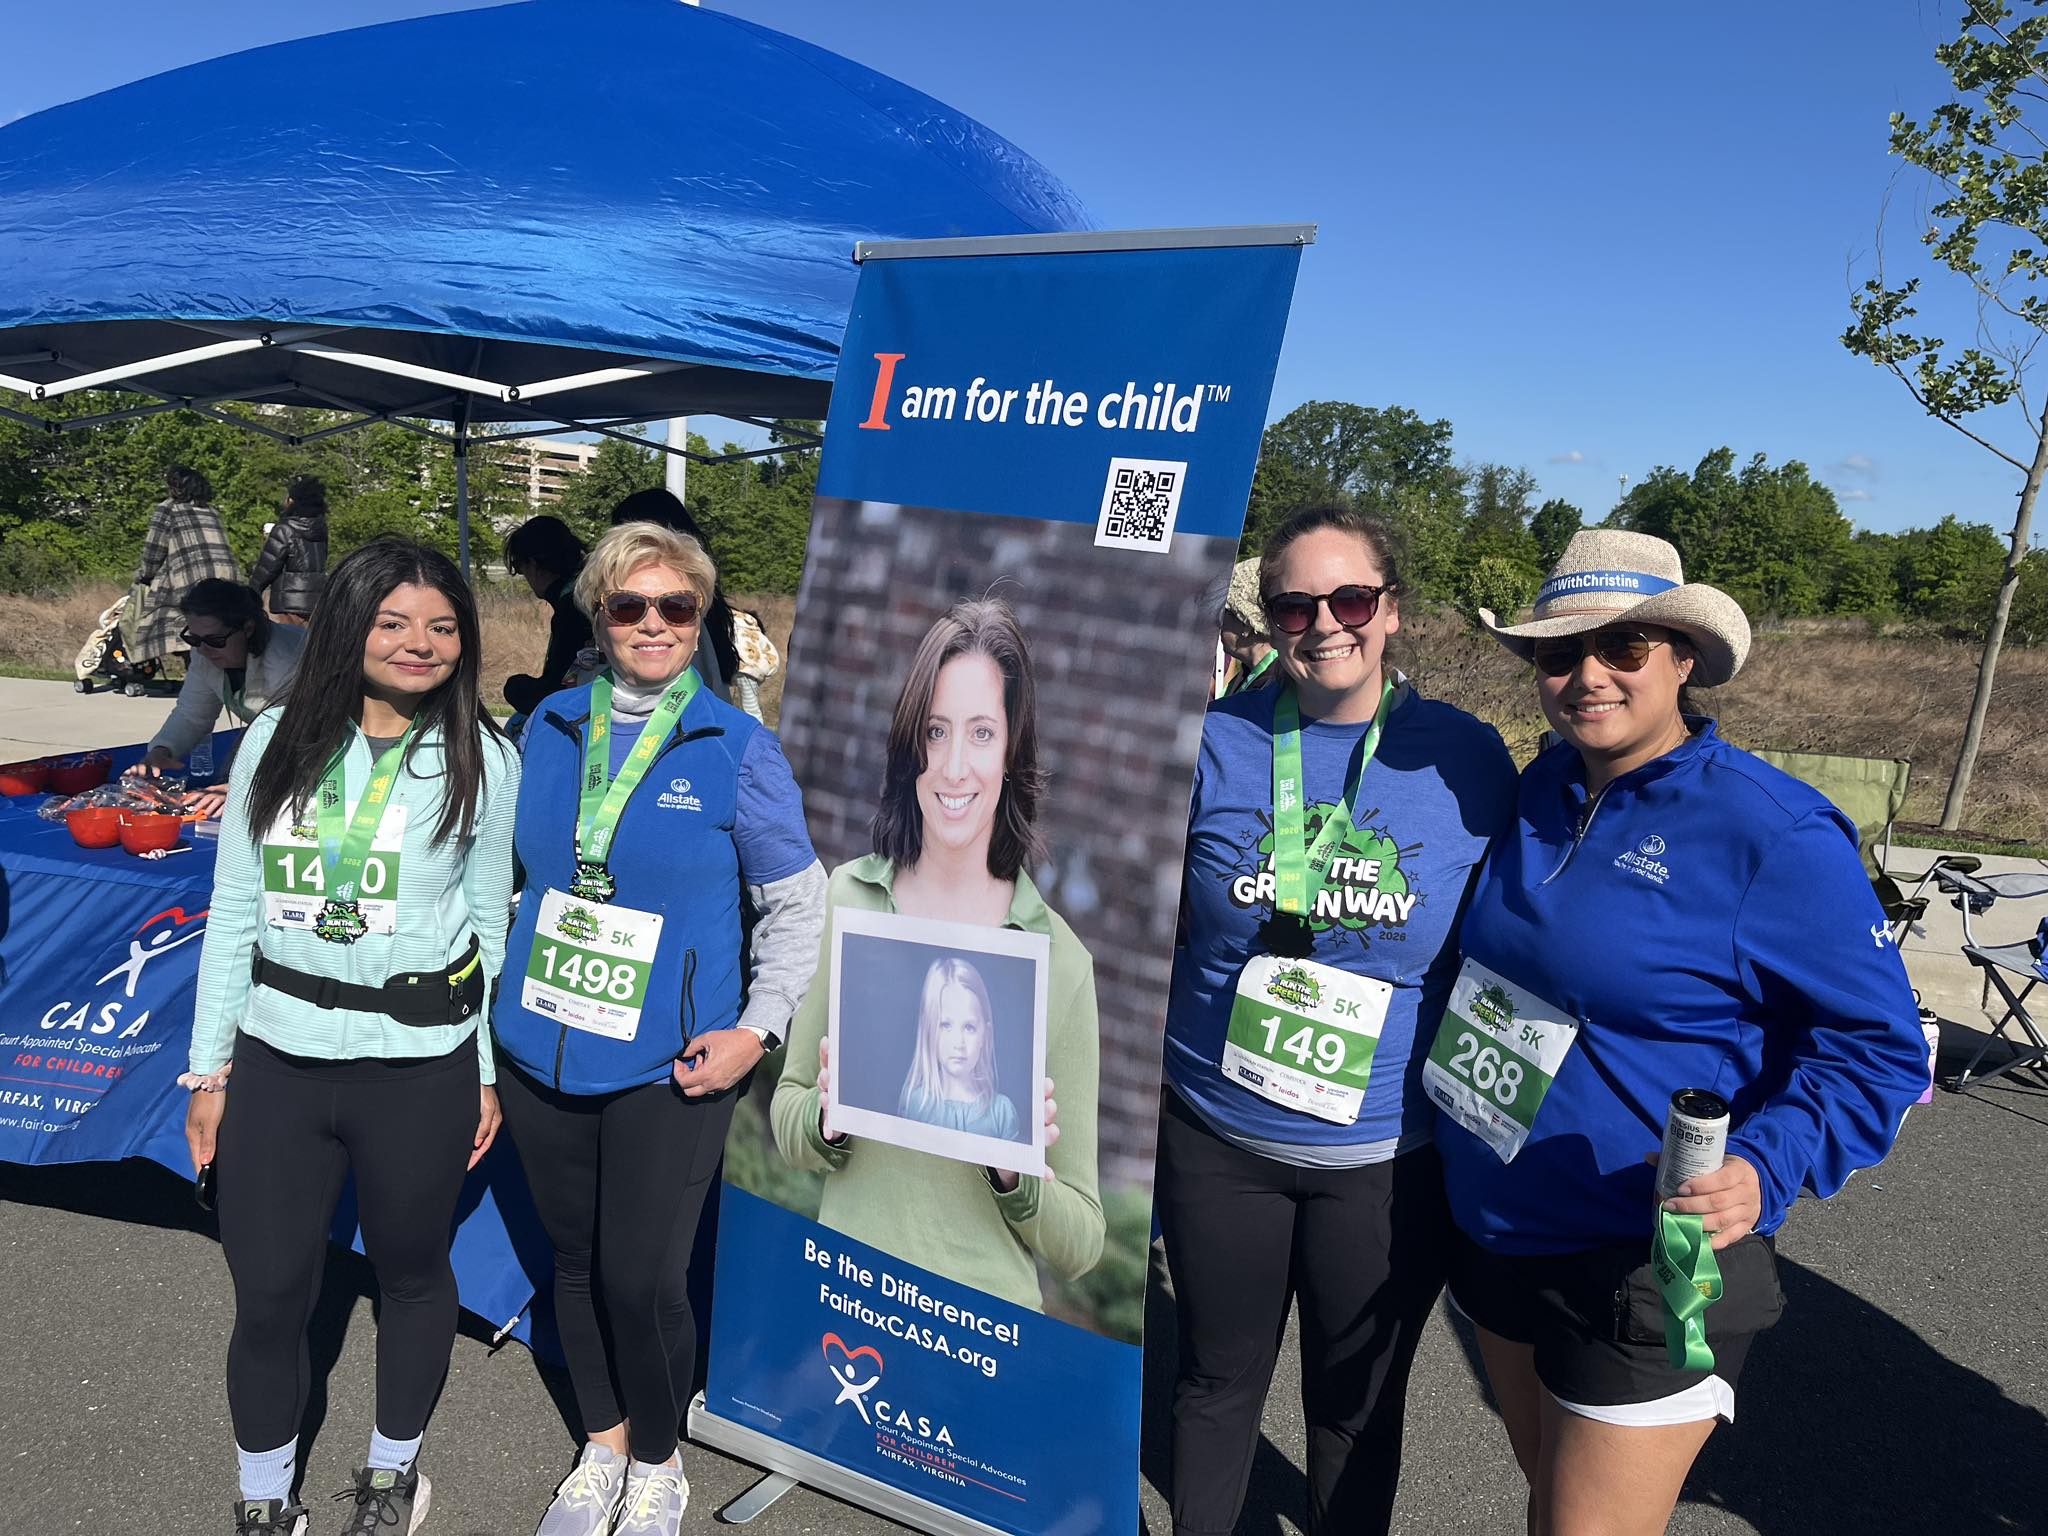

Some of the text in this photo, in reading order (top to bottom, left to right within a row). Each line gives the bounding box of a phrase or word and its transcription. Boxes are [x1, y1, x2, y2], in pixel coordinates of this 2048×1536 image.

[859, 353, 906, 430] I
[902, 385, 957, 421] am
[964, 377, 1019, 423] for
[1024, 379, 1088, 428] the
[657, 792, 701, 806] Allstate
[277, 852, 387, 895] 140
[1330, 856, 1382, 883] THE
[1617, 850, 1668, 877] Allstate
[1233, 872, 1416, 923] GRNWAY
[282, 911, 305, 920] CLARK
[611, 930, 636, 948] 5K
[1379, 931, 1406, 942] 2026
[542, 945, 637, 1001] 1498
[1280, 979, 1313, 995] RUN THE
[41, 1001, 150, 1039] CASA
[1333, 998, 1362, 1019] 5K
[20, 1034, 72, 1051] Appointed
[75, 1037, 124, 1059] Special
[1260, 1015, 1346, 1075] 149
[1519, 1024, 1545, 1051] 5K
[14, 1053, 41, 1068] FOR
[1239, 1067, 1264, 1085] CLARK
[1448, 1031, 1524, 1106] 268
[1278, 1086, 1299, 1100] leidos
[805, 1238, 1019, 1347] Be the Difference!
[820, 1284, 997, 1377] FairfaxCASA.org
[875, 1400, 954, 1447] CASA
[876, 1432, 955, 1469] FOR CHILDREN
[876, 1420, 1027, 1486] Court Appointed Special Advocates
[876, 1446, 966, 1487] FAIRFAX, VIRGINIA
